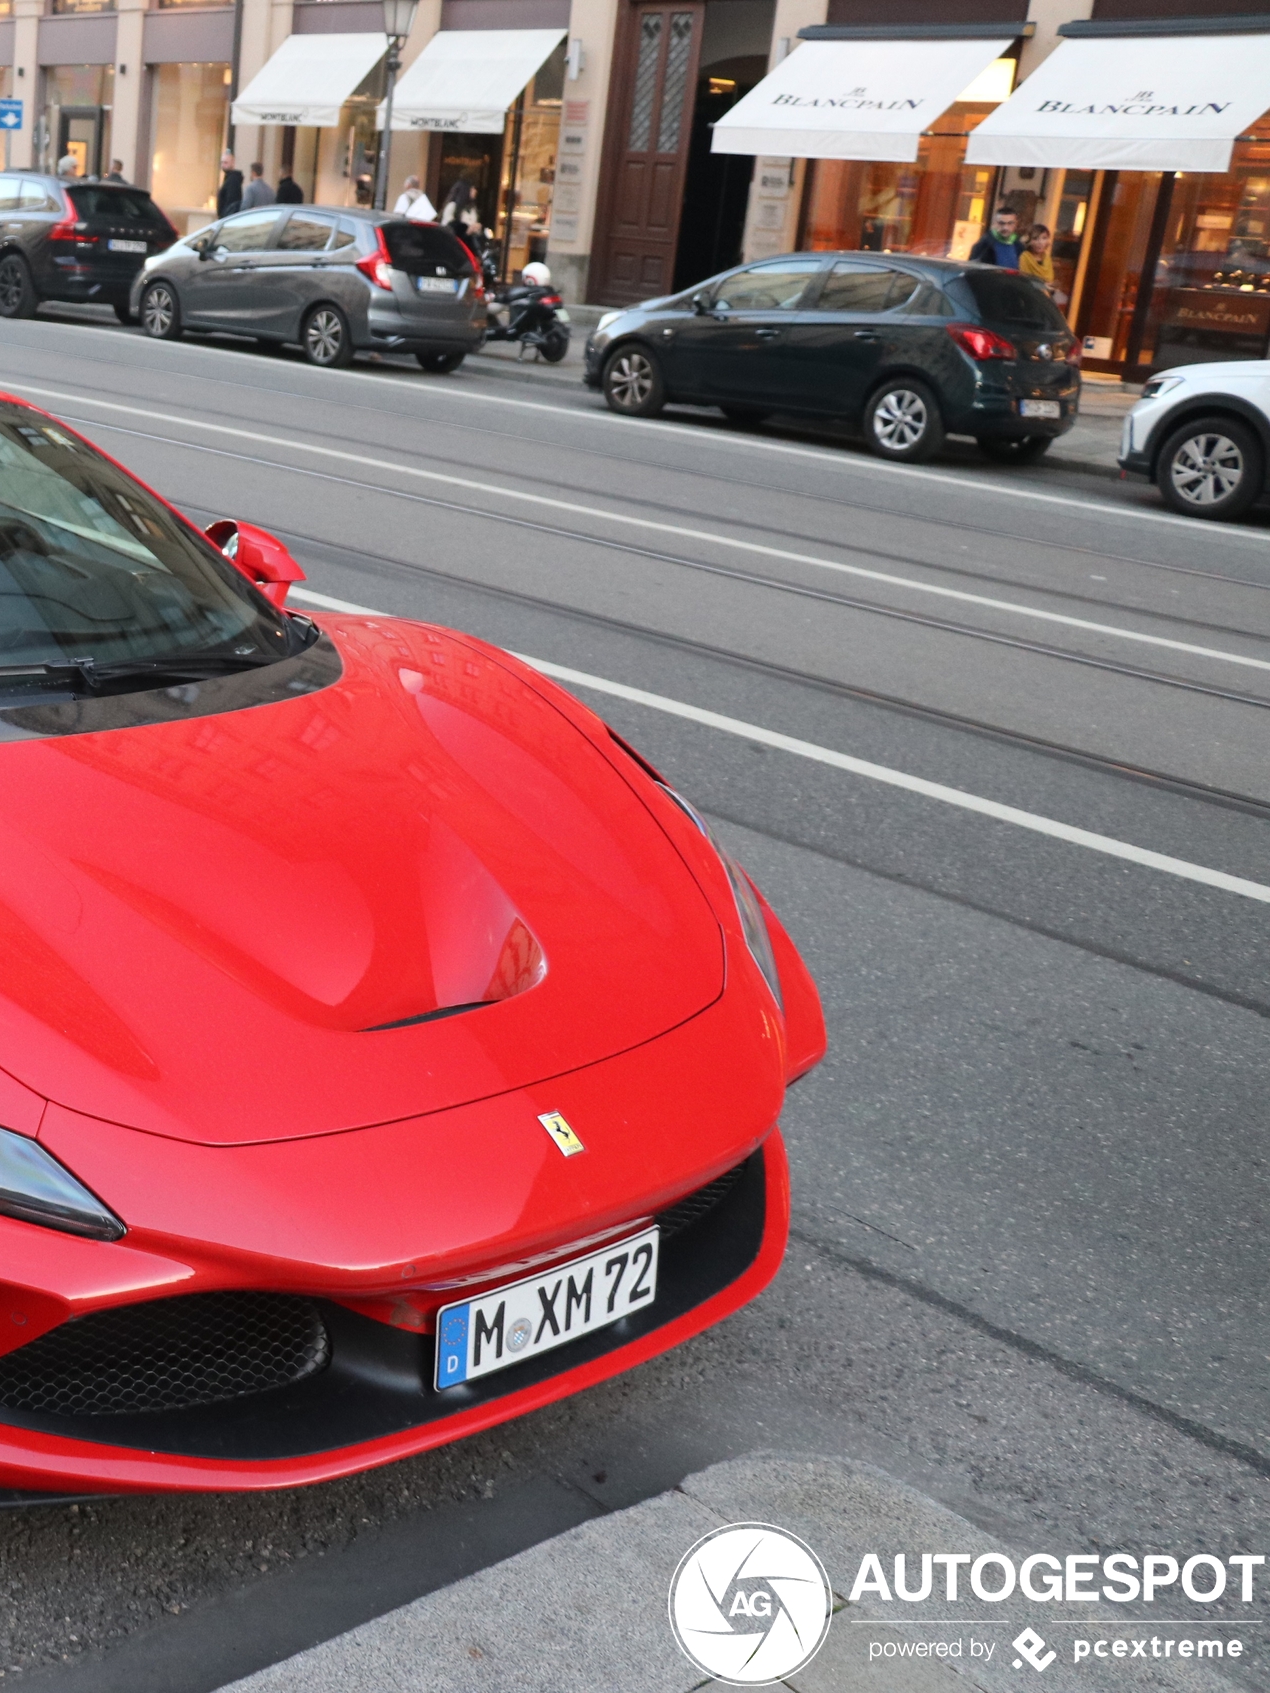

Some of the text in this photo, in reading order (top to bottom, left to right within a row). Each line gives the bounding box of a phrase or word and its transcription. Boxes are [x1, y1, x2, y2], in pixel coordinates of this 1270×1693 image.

[771, 94, 925, 109] BLANCPAIN
[1035, 100, 1233, 115] BLANCPAIN
[411, 117, 459, 129] MONTBLANC
[1177, 307, 1259, 323] BLANCPAIN
[473, 1243, 653, 1367] M XM 72
[447, 1355, 459, 1373] D
